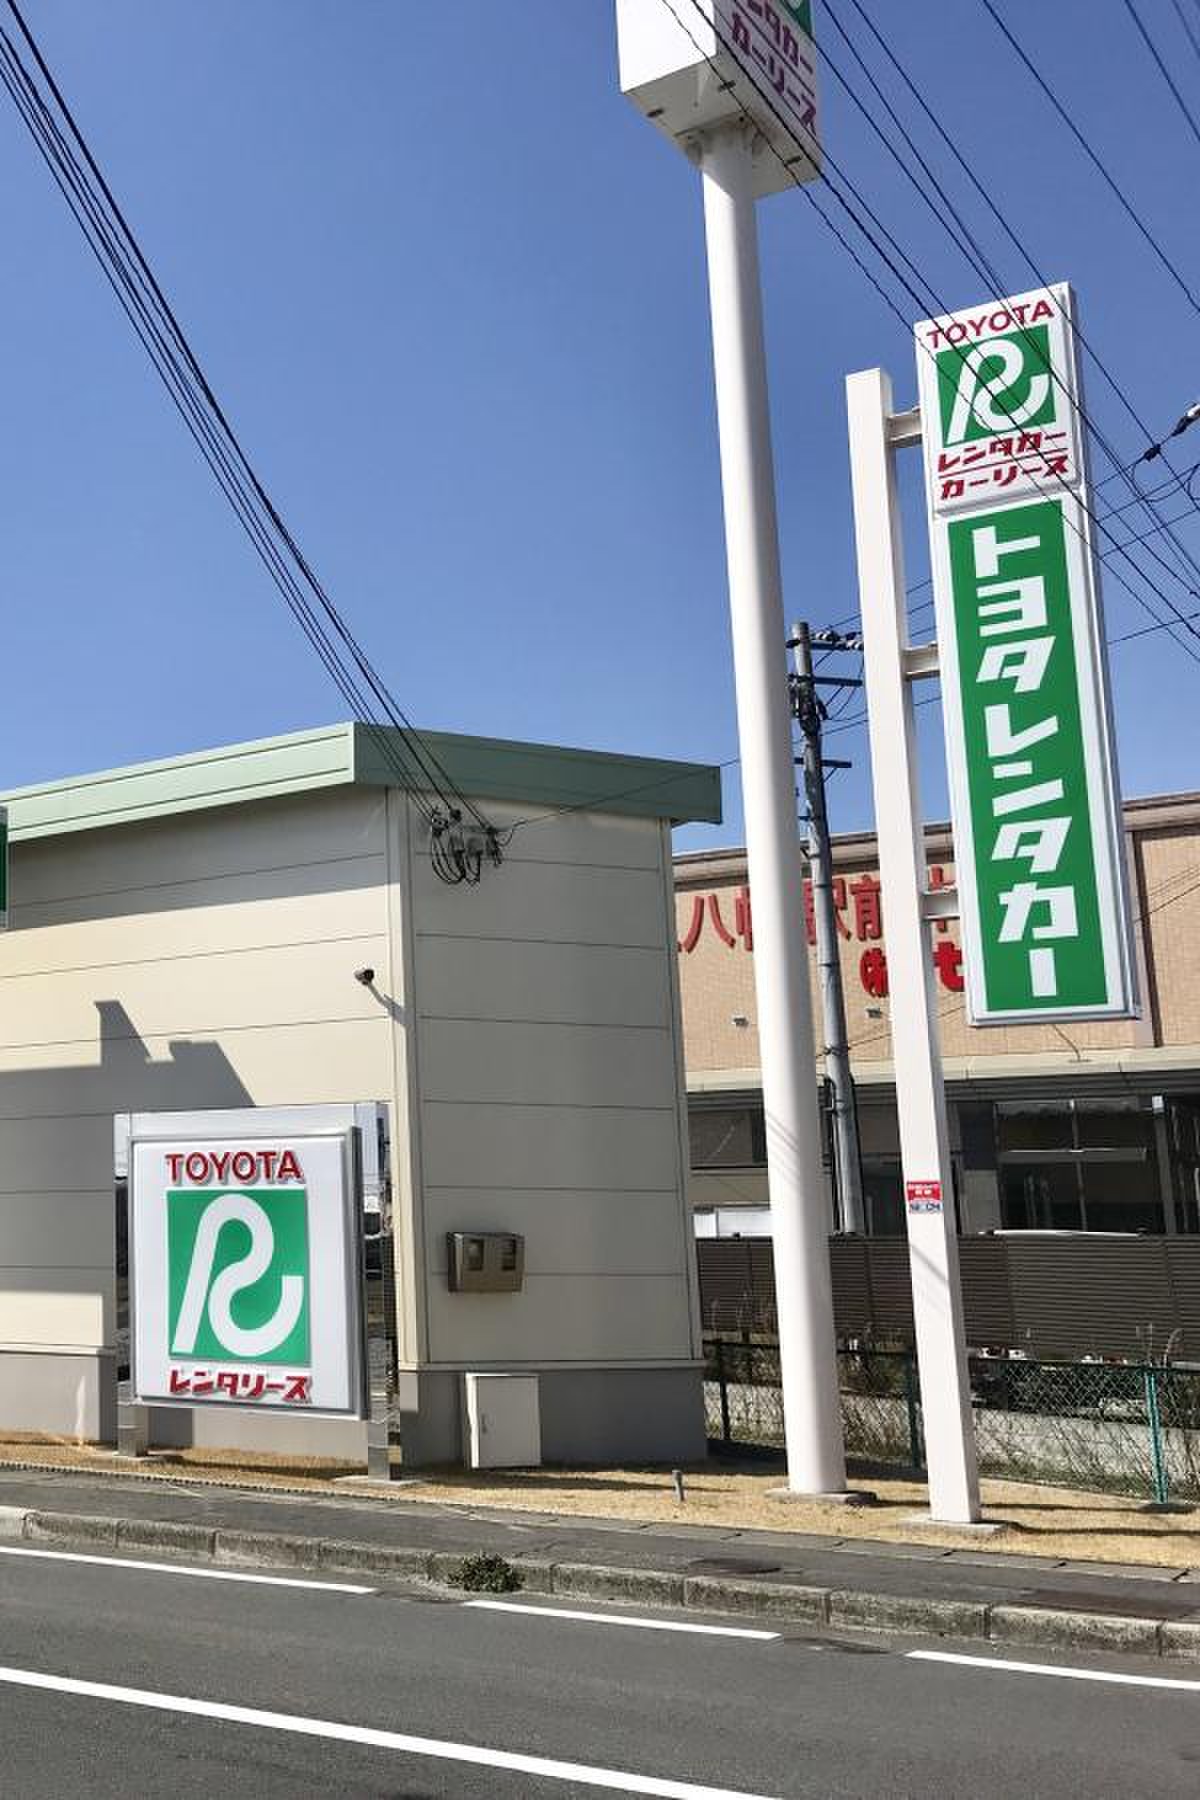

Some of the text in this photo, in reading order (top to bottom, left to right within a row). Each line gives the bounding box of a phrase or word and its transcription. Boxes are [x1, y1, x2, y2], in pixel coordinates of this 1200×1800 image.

[926, 300, 1054, 349] TOYOTA
[937, 431, 1067, 473] レンタカー
[940, 455, 1069, 500] カーリース
[972, 525, 1079, 997] トヨタレンタカー
[165, 1151, 303, 1181] TOYOTA
[169, 1370, 311, 1401] レンタリース
